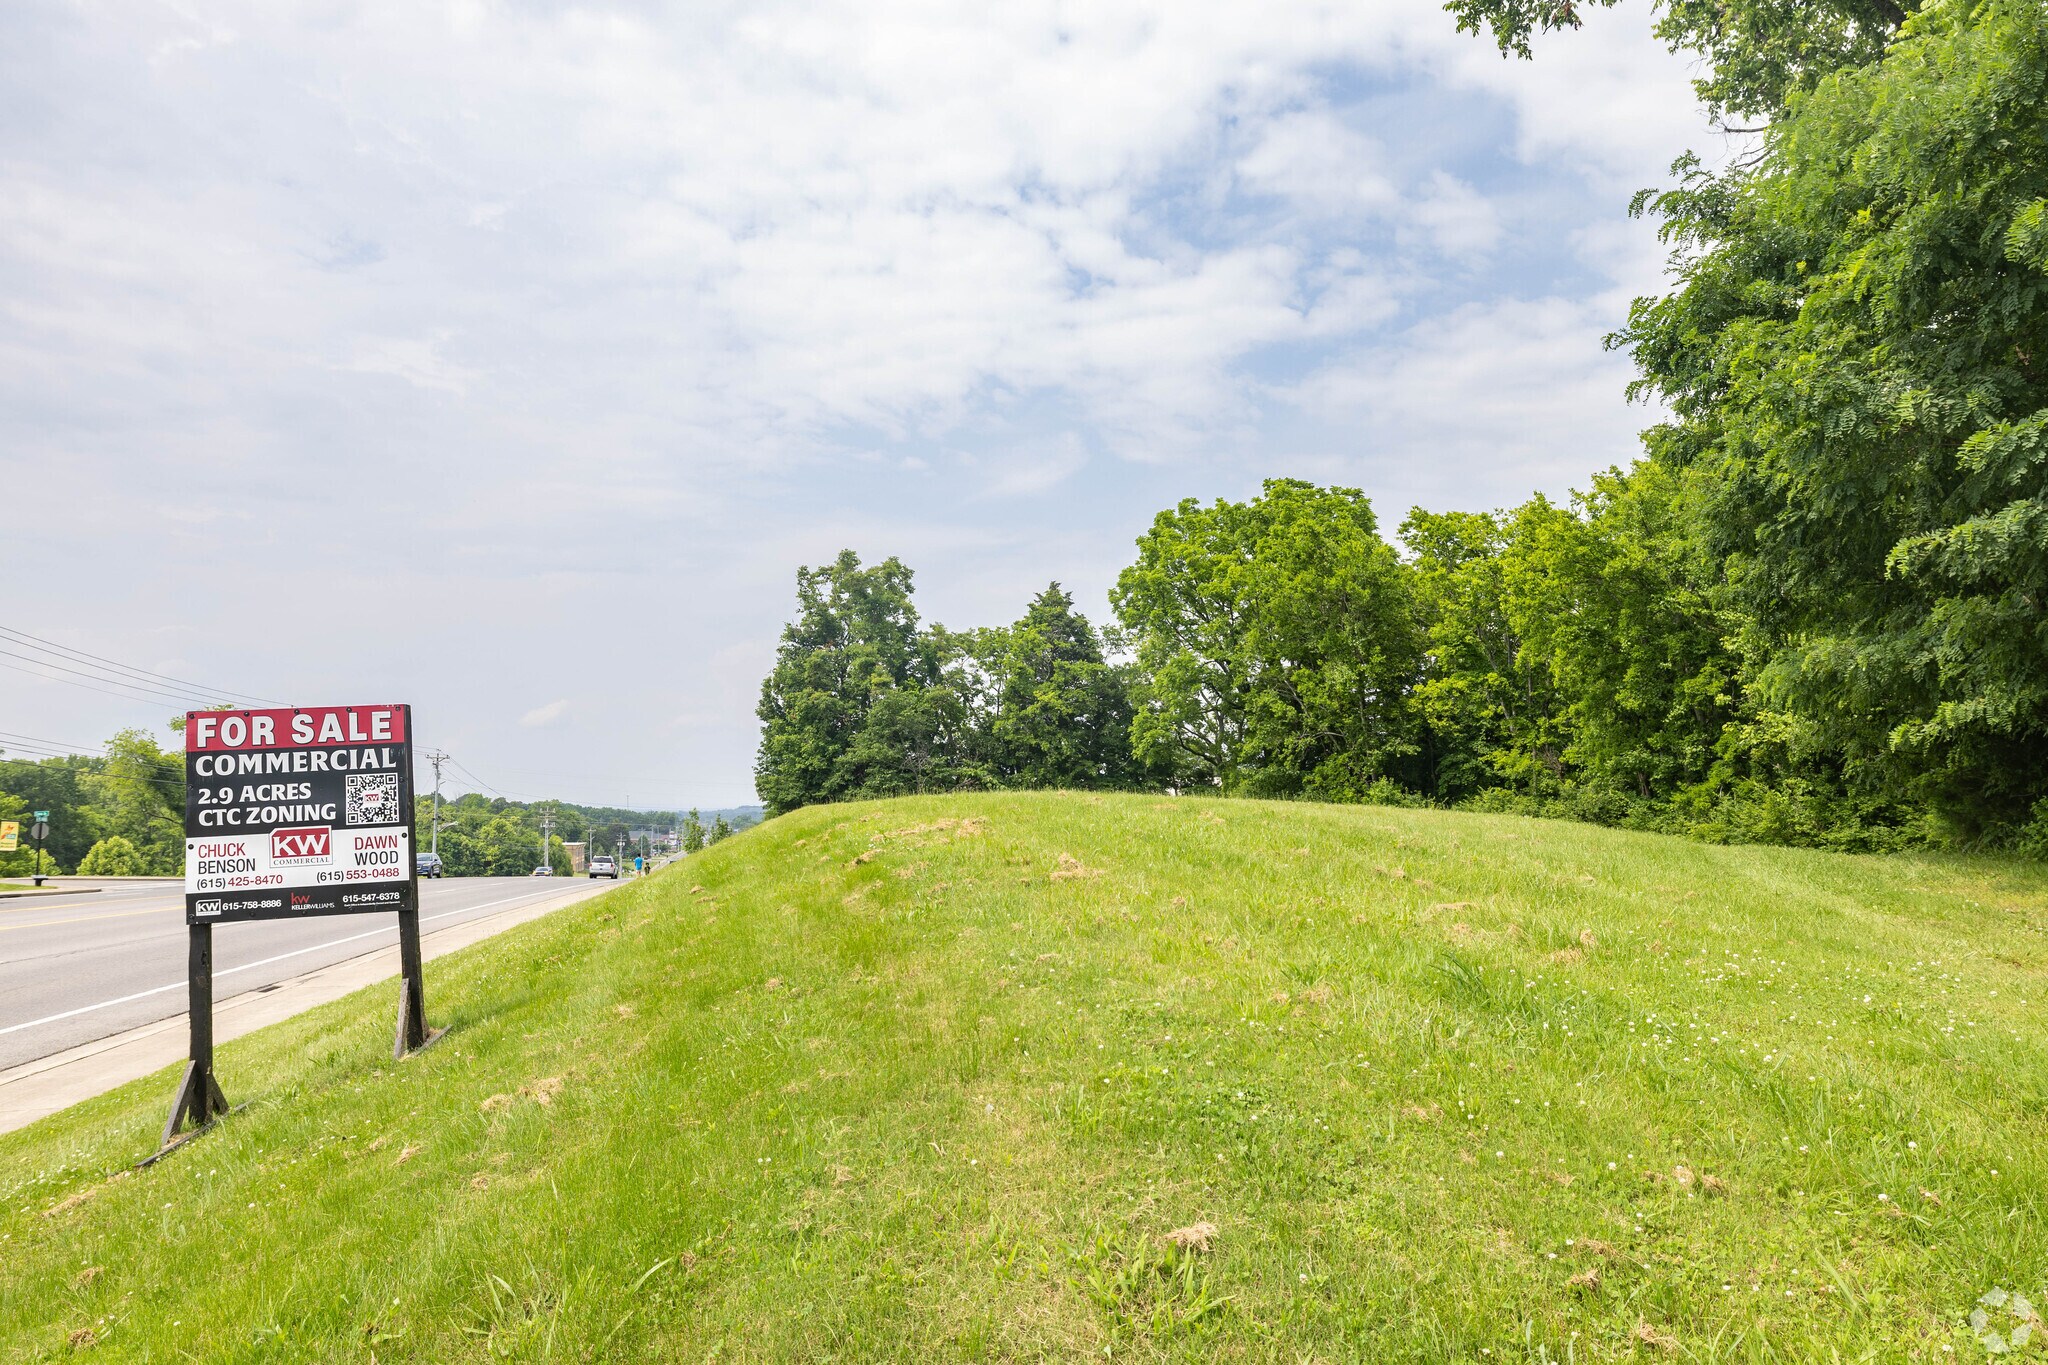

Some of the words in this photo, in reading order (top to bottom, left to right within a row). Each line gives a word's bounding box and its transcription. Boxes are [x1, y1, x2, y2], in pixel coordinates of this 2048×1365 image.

[197, 716, 276, 748] FOR
[291, 710, 392, 744] SALE
[195, 747, 397, 777] COMMERCIAL
[198, 787, 234, 805] 2.9
[239, 783, 311, 803] ACRES
[198, 808, 241, 827] CTC
[246, 803, 336, 825] ZONING
[272, 833, 330, 858] KW
[354, 835, 398, 850] DAWN
[199, 843, 246, 858] CHUCK
[273, 857, 330, 866] COMMERCIAL
[354, 851, 399, 866] WOOD
[198, 858, 256, 875] BENSON
[196, 877, 226, 891] (615)
[227, 874, 283, 887] 425-8470
[316, 871, 344, 884] (615)
[346, 868, 400, 880] 553-0488
[222, 899, 282, 911] 615-758-8886
[291, 892, 310, 904] kw
[342, 892, 400, 903] 615-547-6378
[198, 902, 218, 912] KW
